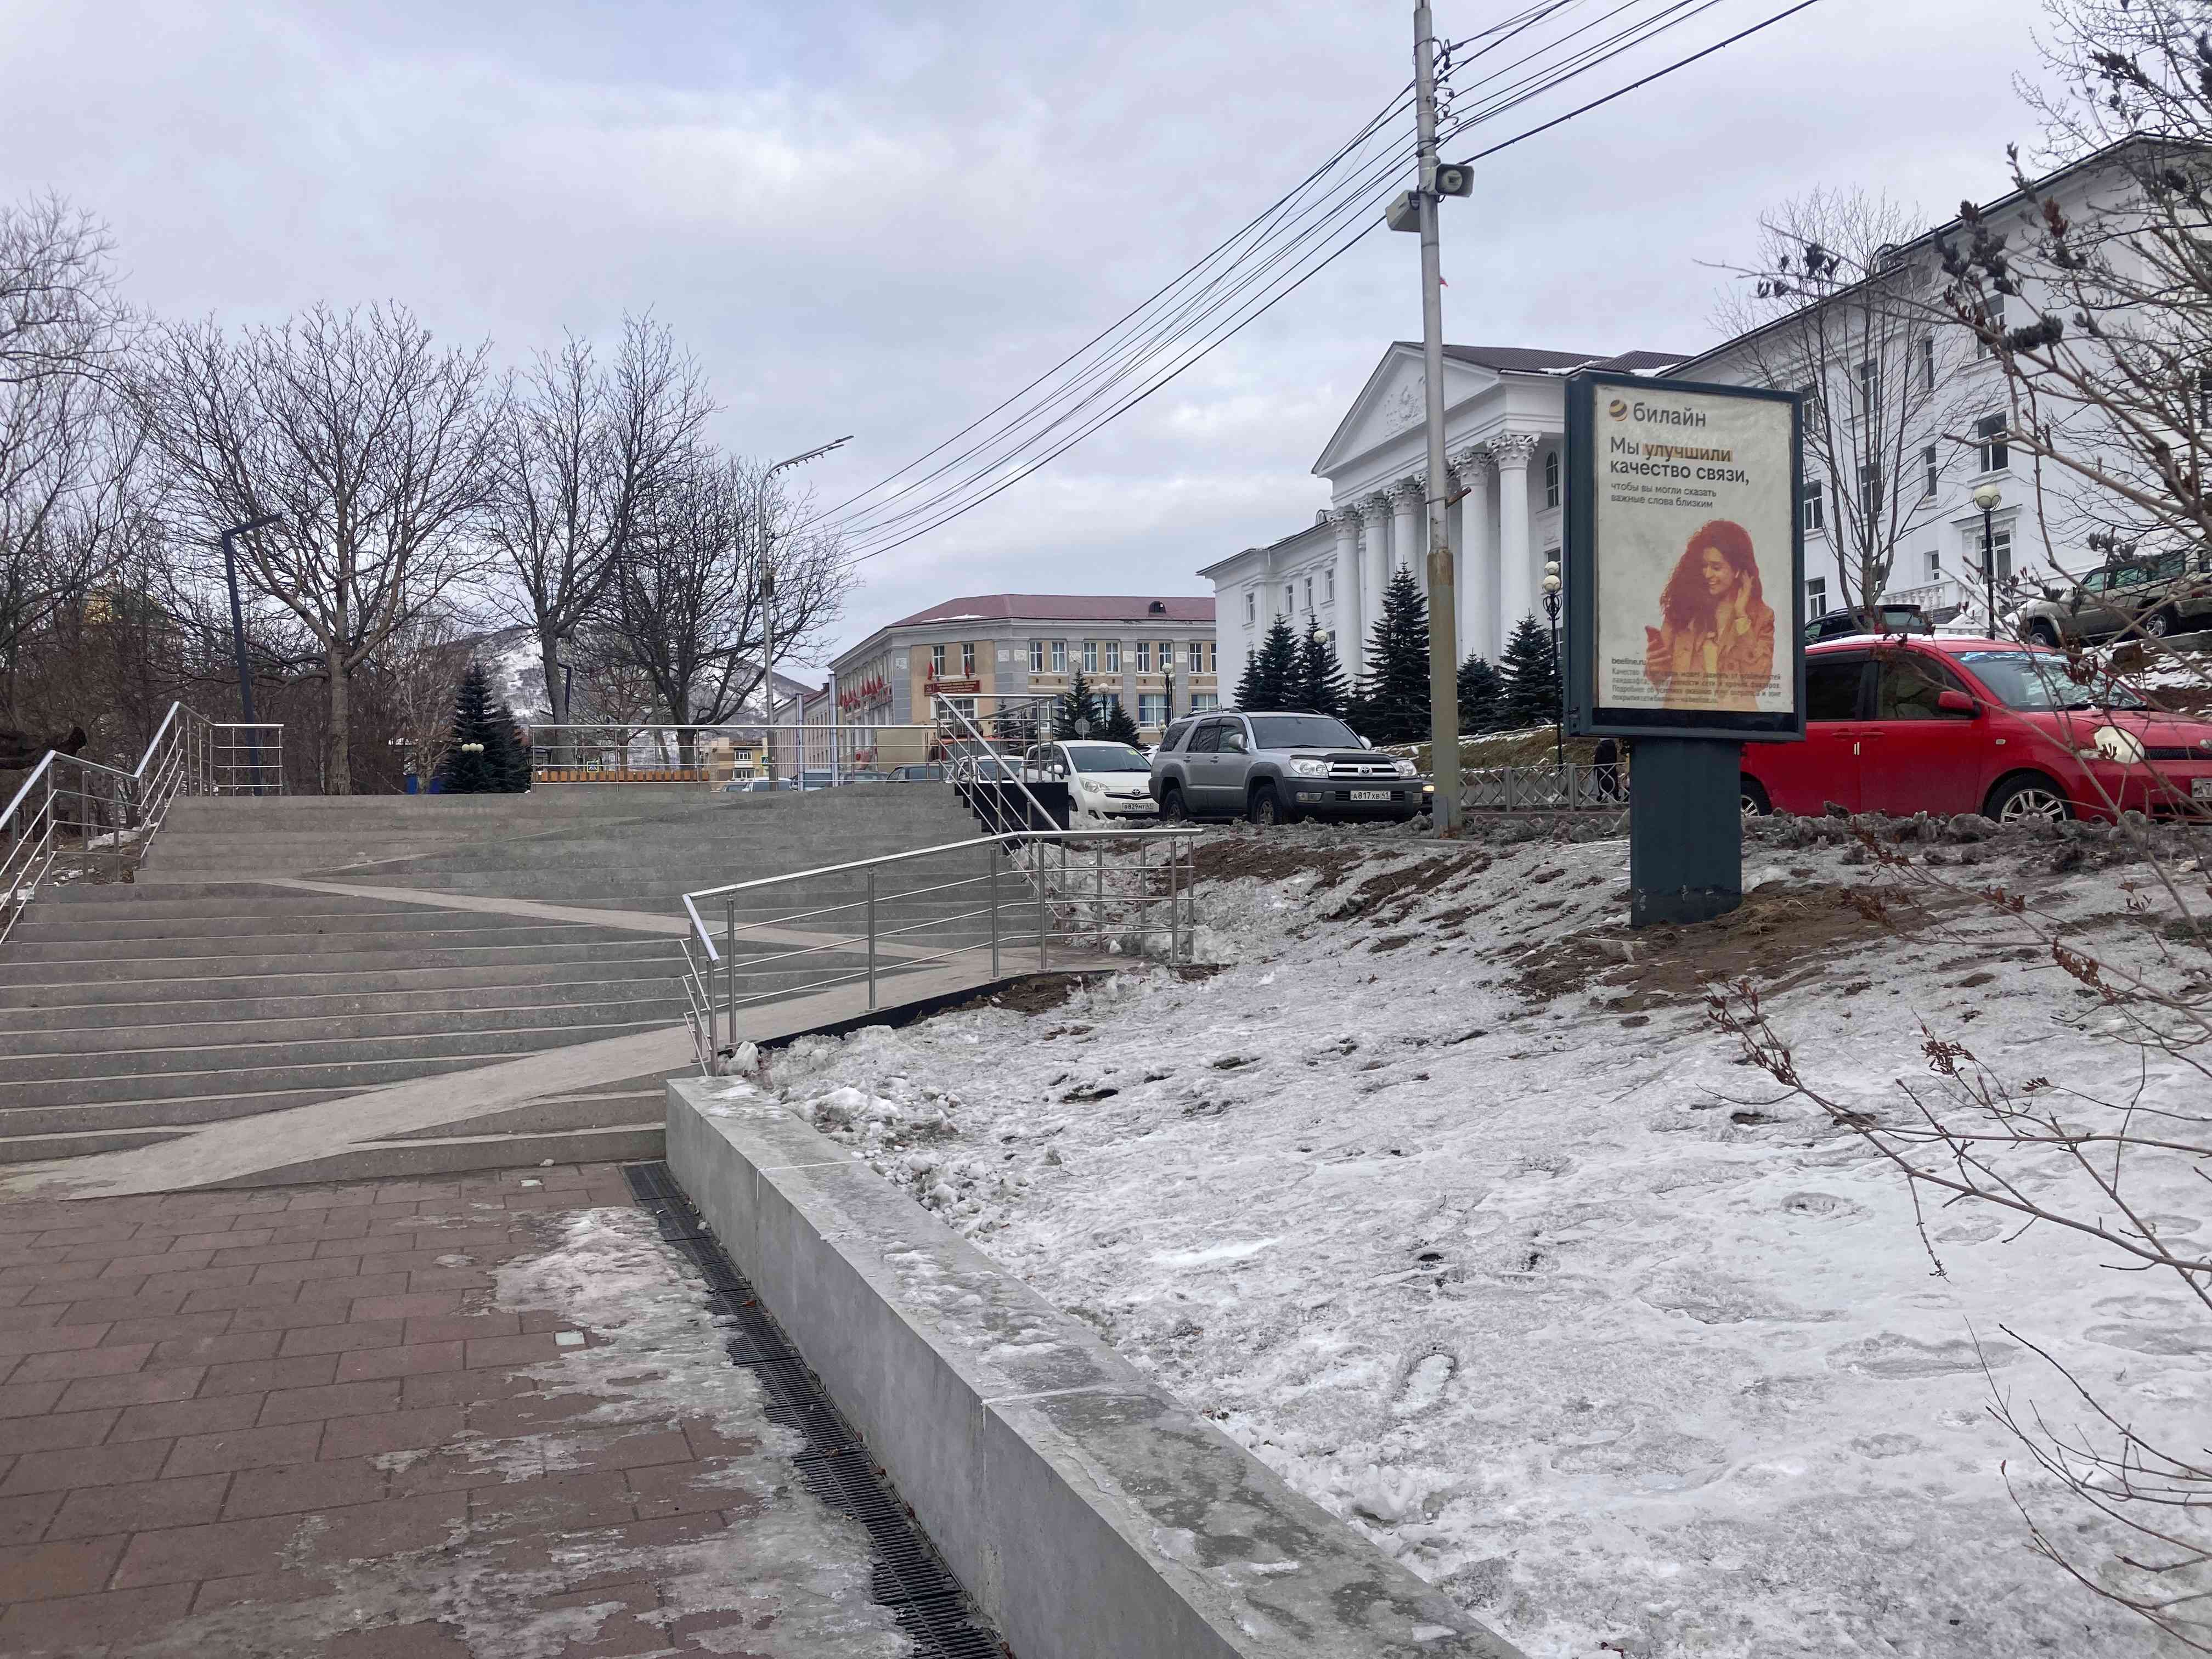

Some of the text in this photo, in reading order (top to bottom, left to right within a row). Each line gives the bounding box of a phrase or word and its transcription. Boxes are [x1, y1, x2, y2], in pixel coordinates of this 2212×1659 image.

[1633, 402, 1706, 427] билайн
[1610, 437, 1731, 462] Мы улучшили
[1610, 460, 1750, 486] качество связи,
[1611, 482, 1639, 492] чтобы
[1655, 486, 1682, 495] могли
[1684, 489, 1717, 497] сказать
[1611, 495, 1713, 508] важные слова близким
